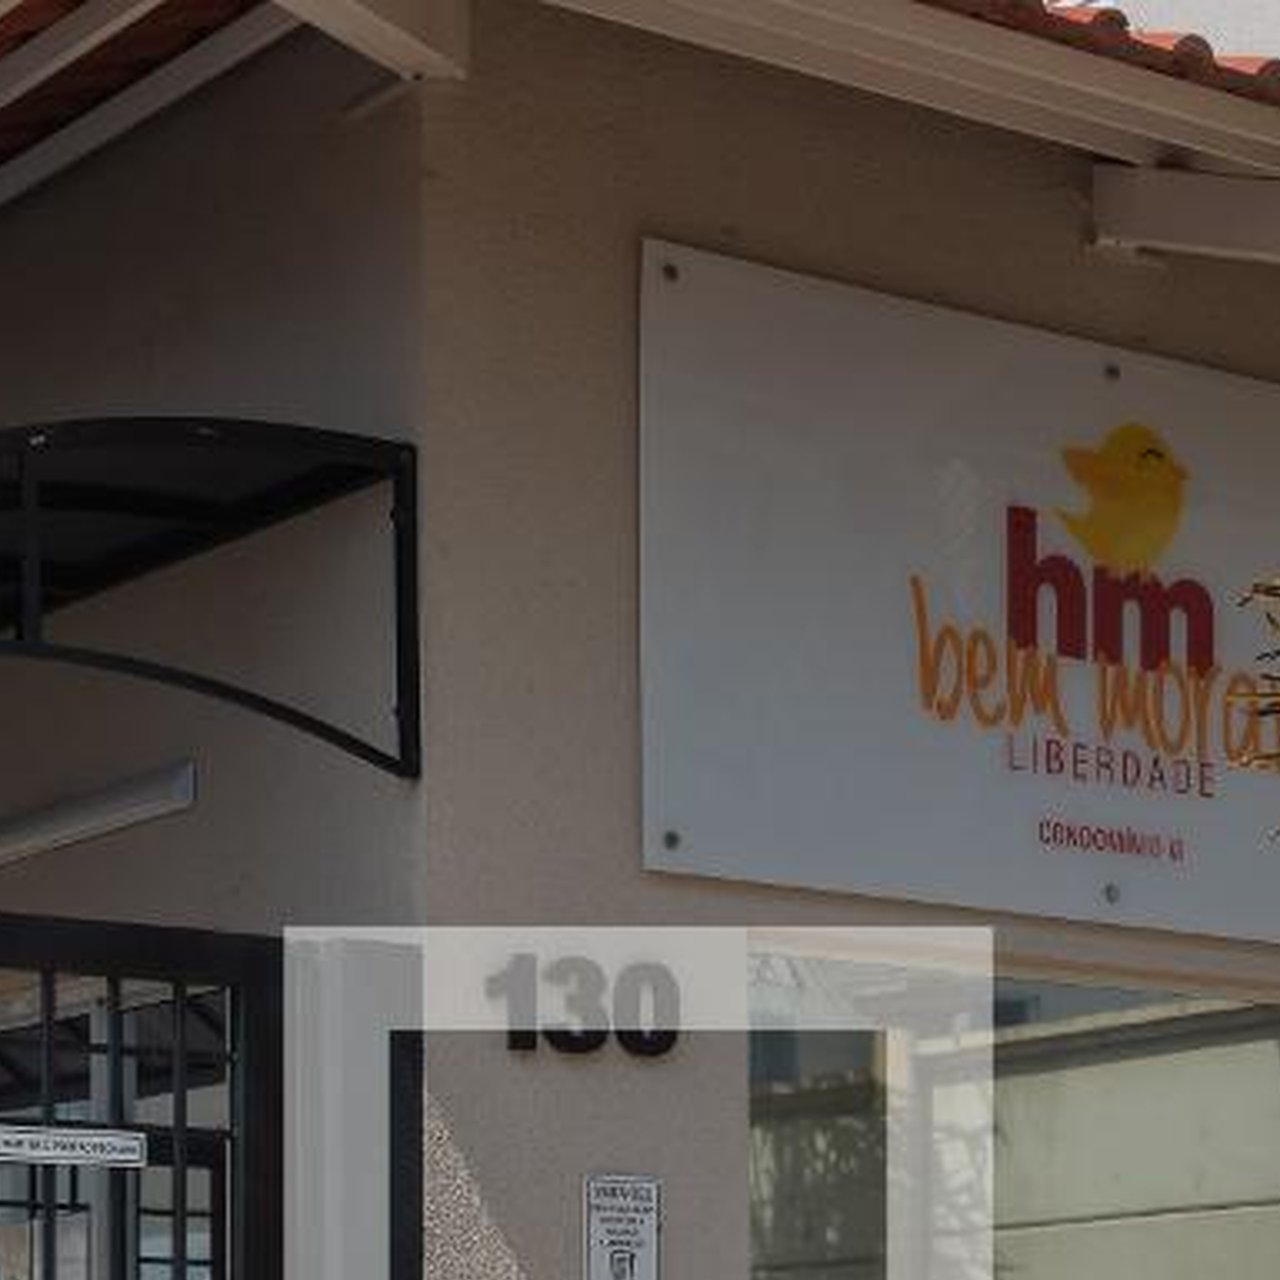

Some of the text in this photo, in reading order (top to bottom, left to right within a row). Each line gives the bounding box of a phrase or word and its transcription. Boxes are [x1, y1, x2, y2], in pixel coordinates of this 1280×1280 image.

[909, 573, 1069, 738] bem
[1006, 504, 1215, 677] hm
[1006, 734, 1216, 799] LIBERDADE
[484, 952, 682, 1058] 130
